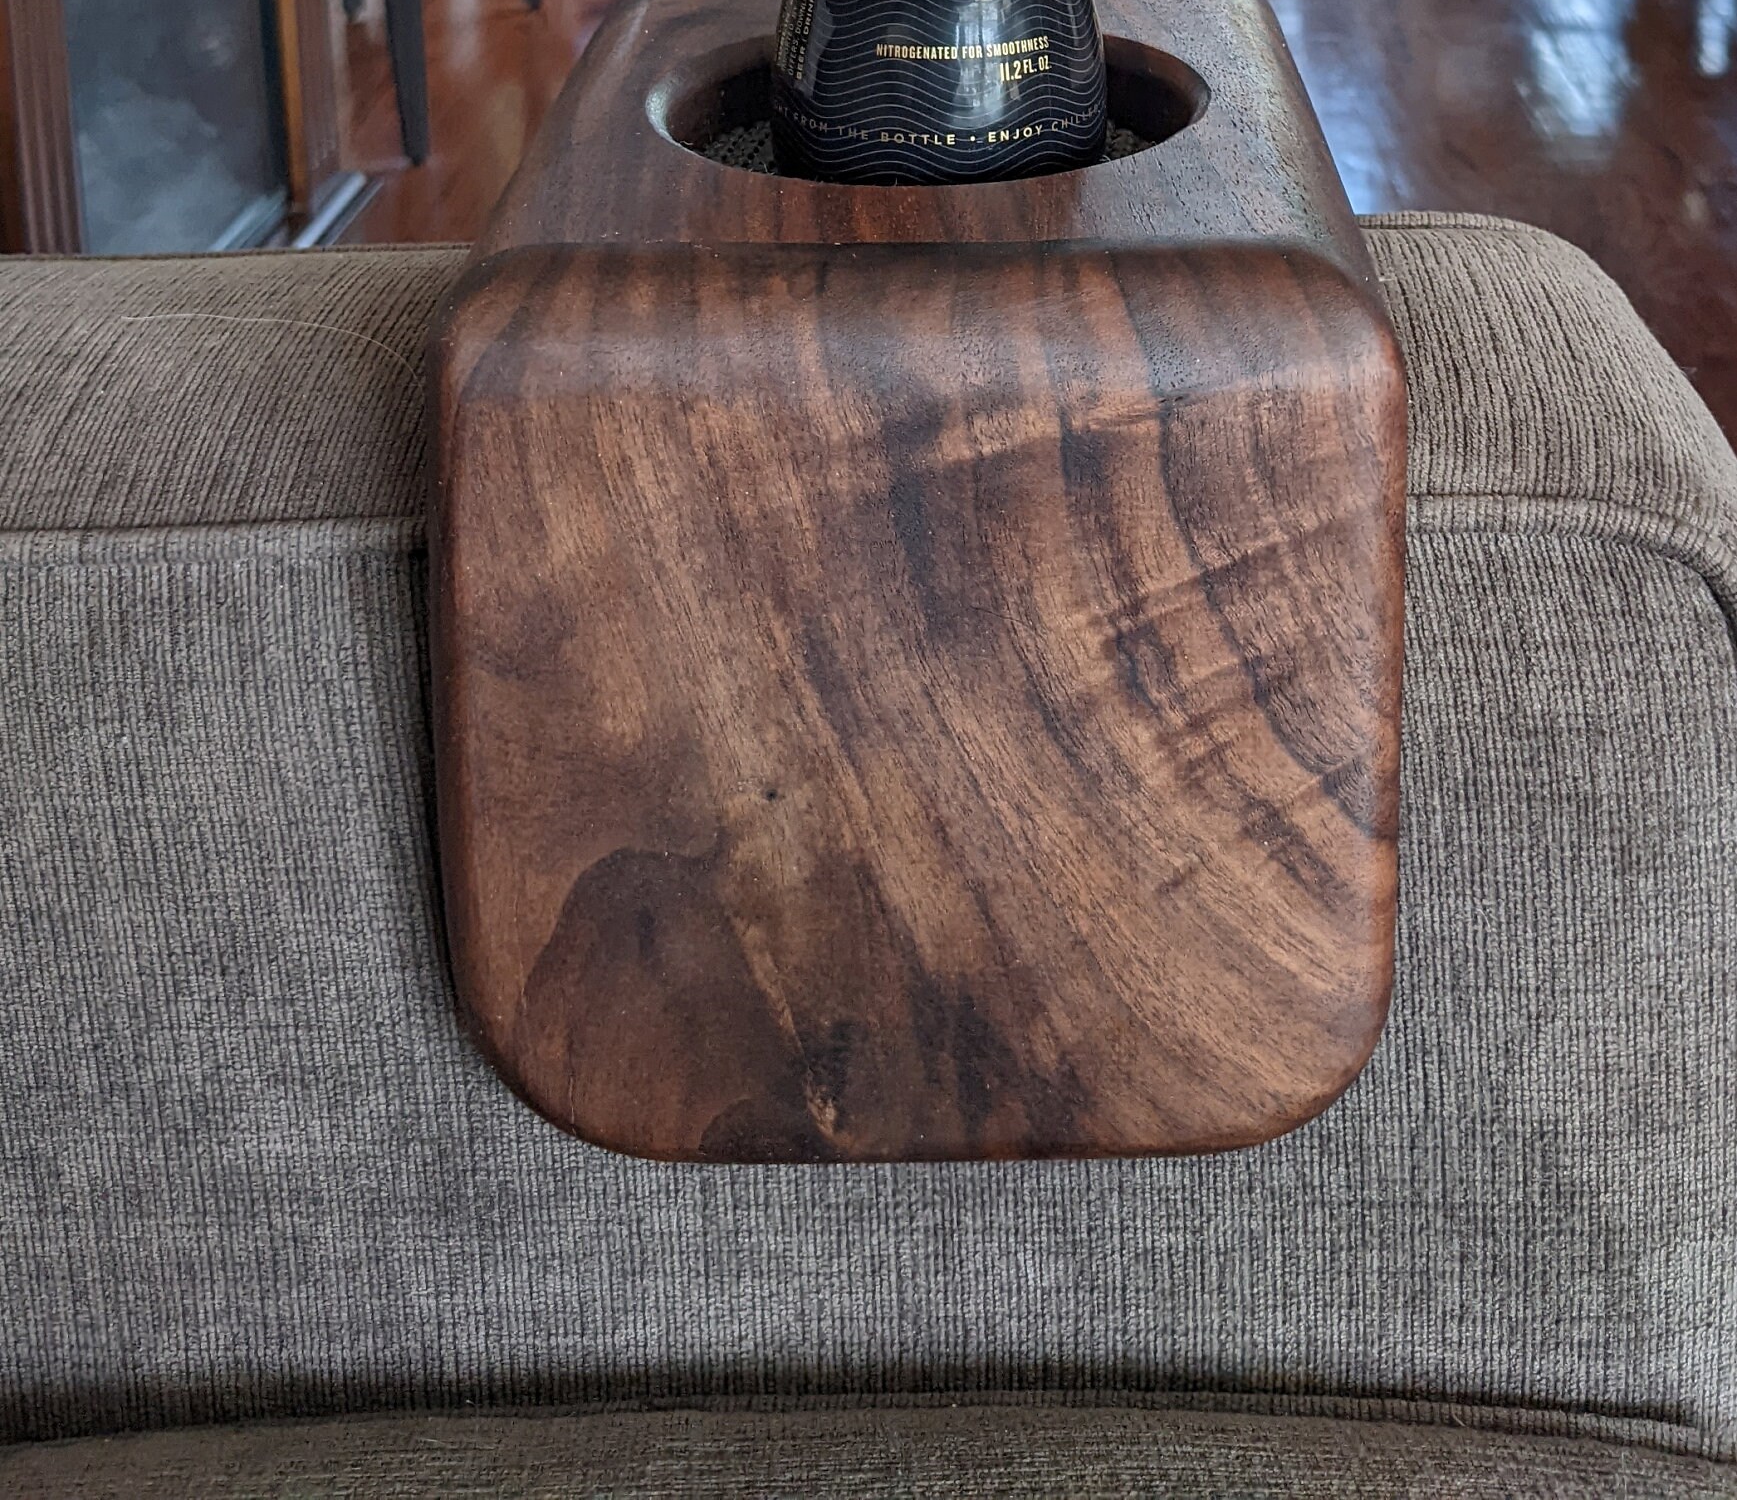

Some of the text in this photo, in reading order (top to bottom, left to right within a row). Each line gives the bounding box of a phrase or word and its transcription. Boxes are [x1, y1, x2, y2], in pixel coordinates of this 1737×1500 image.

[876, 35, 1050, 60] NITROGENATED FOR SMOOTHNESS
[793, 112, 828, 132] FROM
[838, 126, 869, 141] THE
[880, 132, 956, 146] BOTTLE
[988, 124, 1043, 143] ENJOY
